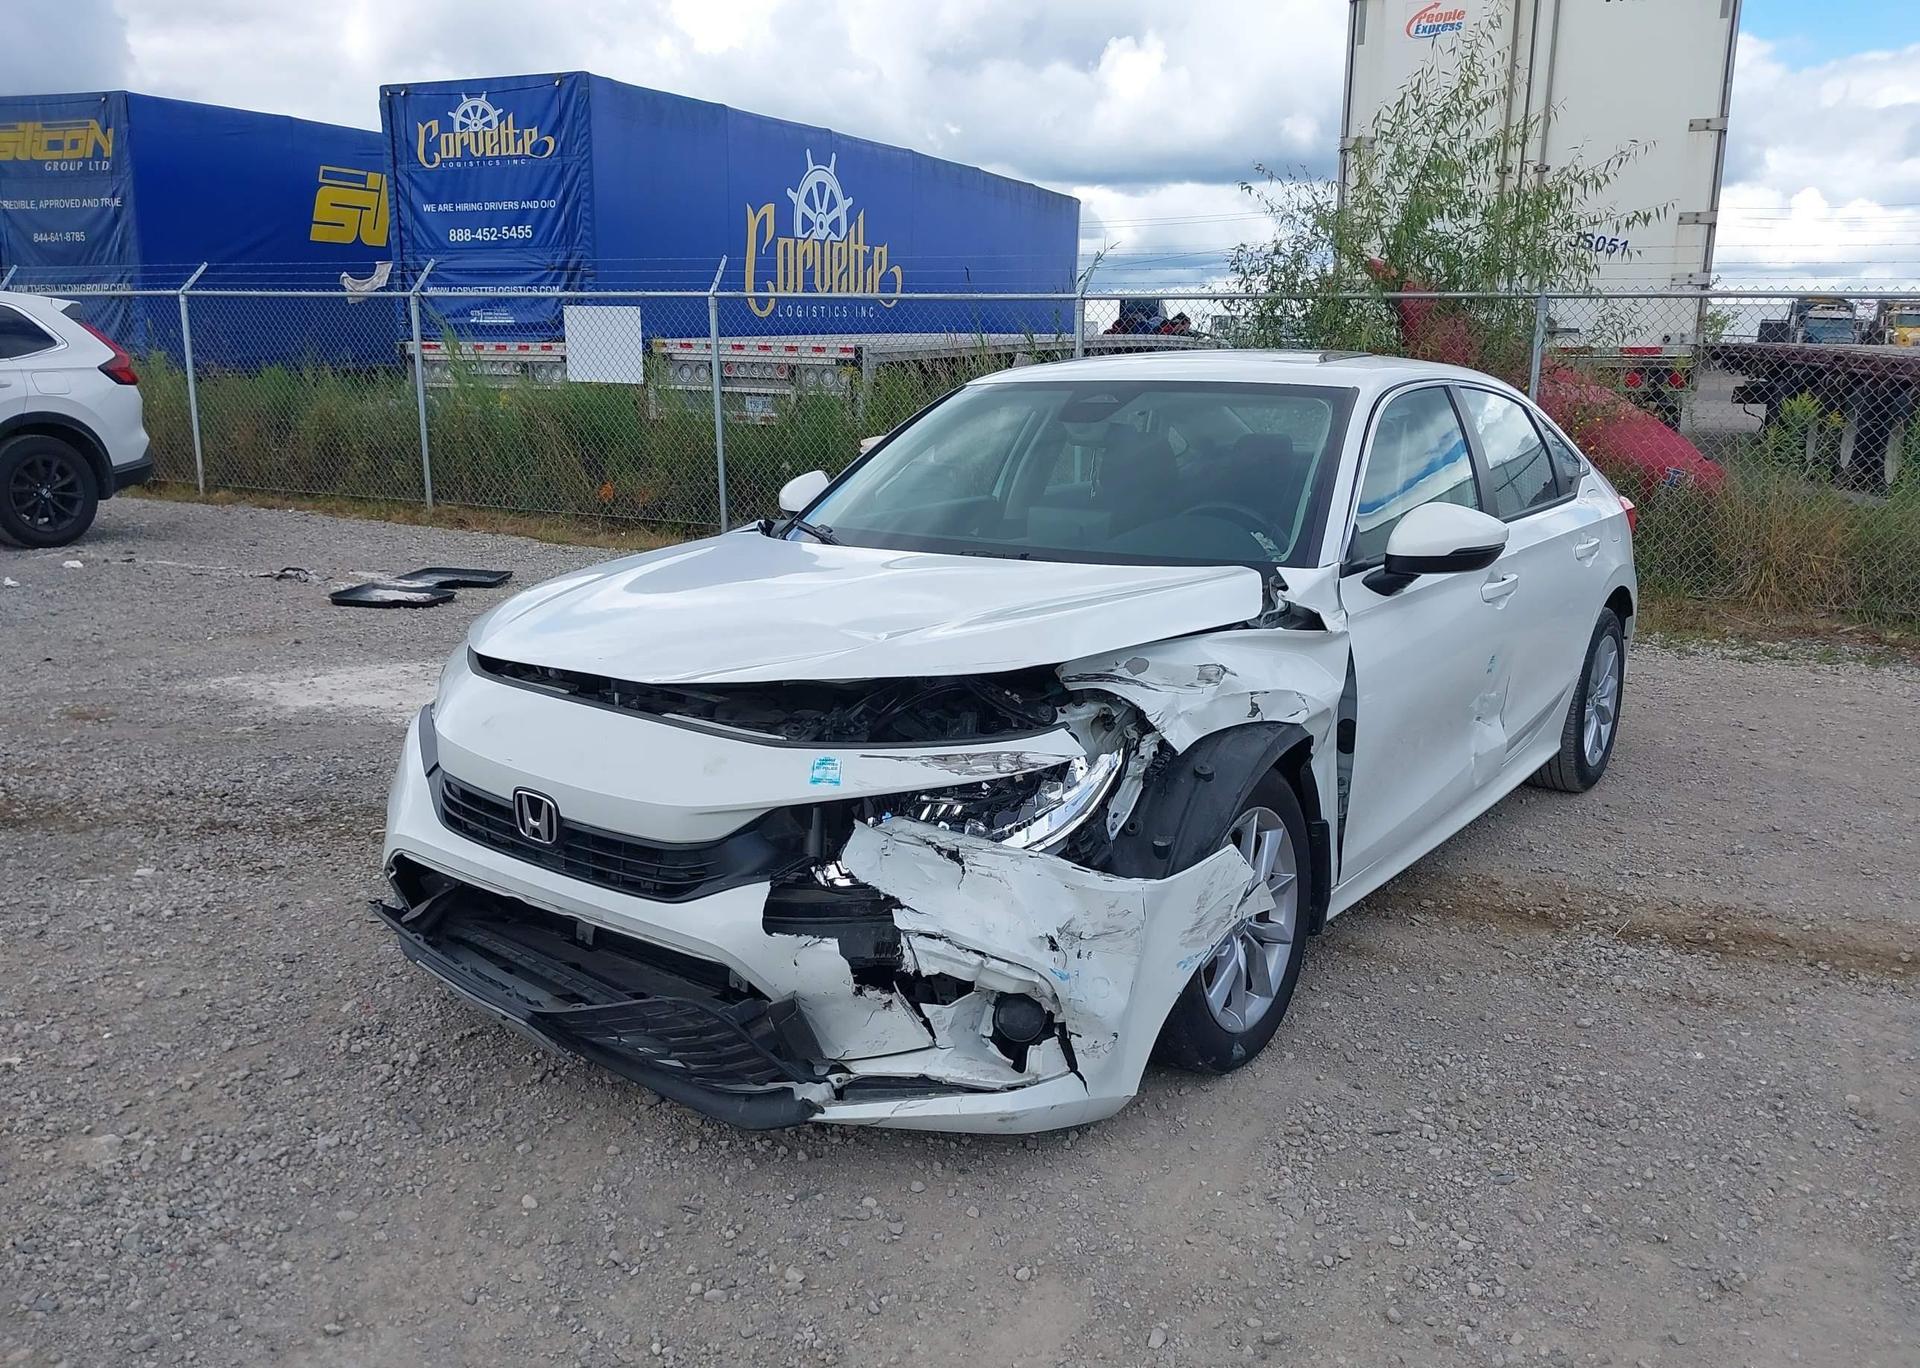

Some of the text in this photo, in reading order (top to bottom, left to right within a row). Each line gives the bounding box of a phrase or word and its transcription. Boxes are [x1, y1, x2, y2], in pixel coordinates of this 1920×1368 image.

[1417, 9, 1466, 23] People
[1414, 21, 1463, 35] Express
[417, 112, 555, 168] Corvette
[44, 161, 109, 171] GROUP LTD
[442, 160, 500, 168] LOGISTICS
[39, 199, 81, 209] APPROVED
[82, 199, 99, 208] AND
[100, 198, 122, 207] TRUE
[423, 204, 436, 212] WE
[438, 203, 454, 212] ARE
[455, 202, 483, 211] HIRING
[484, 201, 519, 211] DRIVERS
[521, 200, 539, 209] AND
[449, 225, 532, 241] 888-452-5455
[744, 203, 903, 318] Corvette
[778, 305, 880, 318] LOGISTICS INC.
